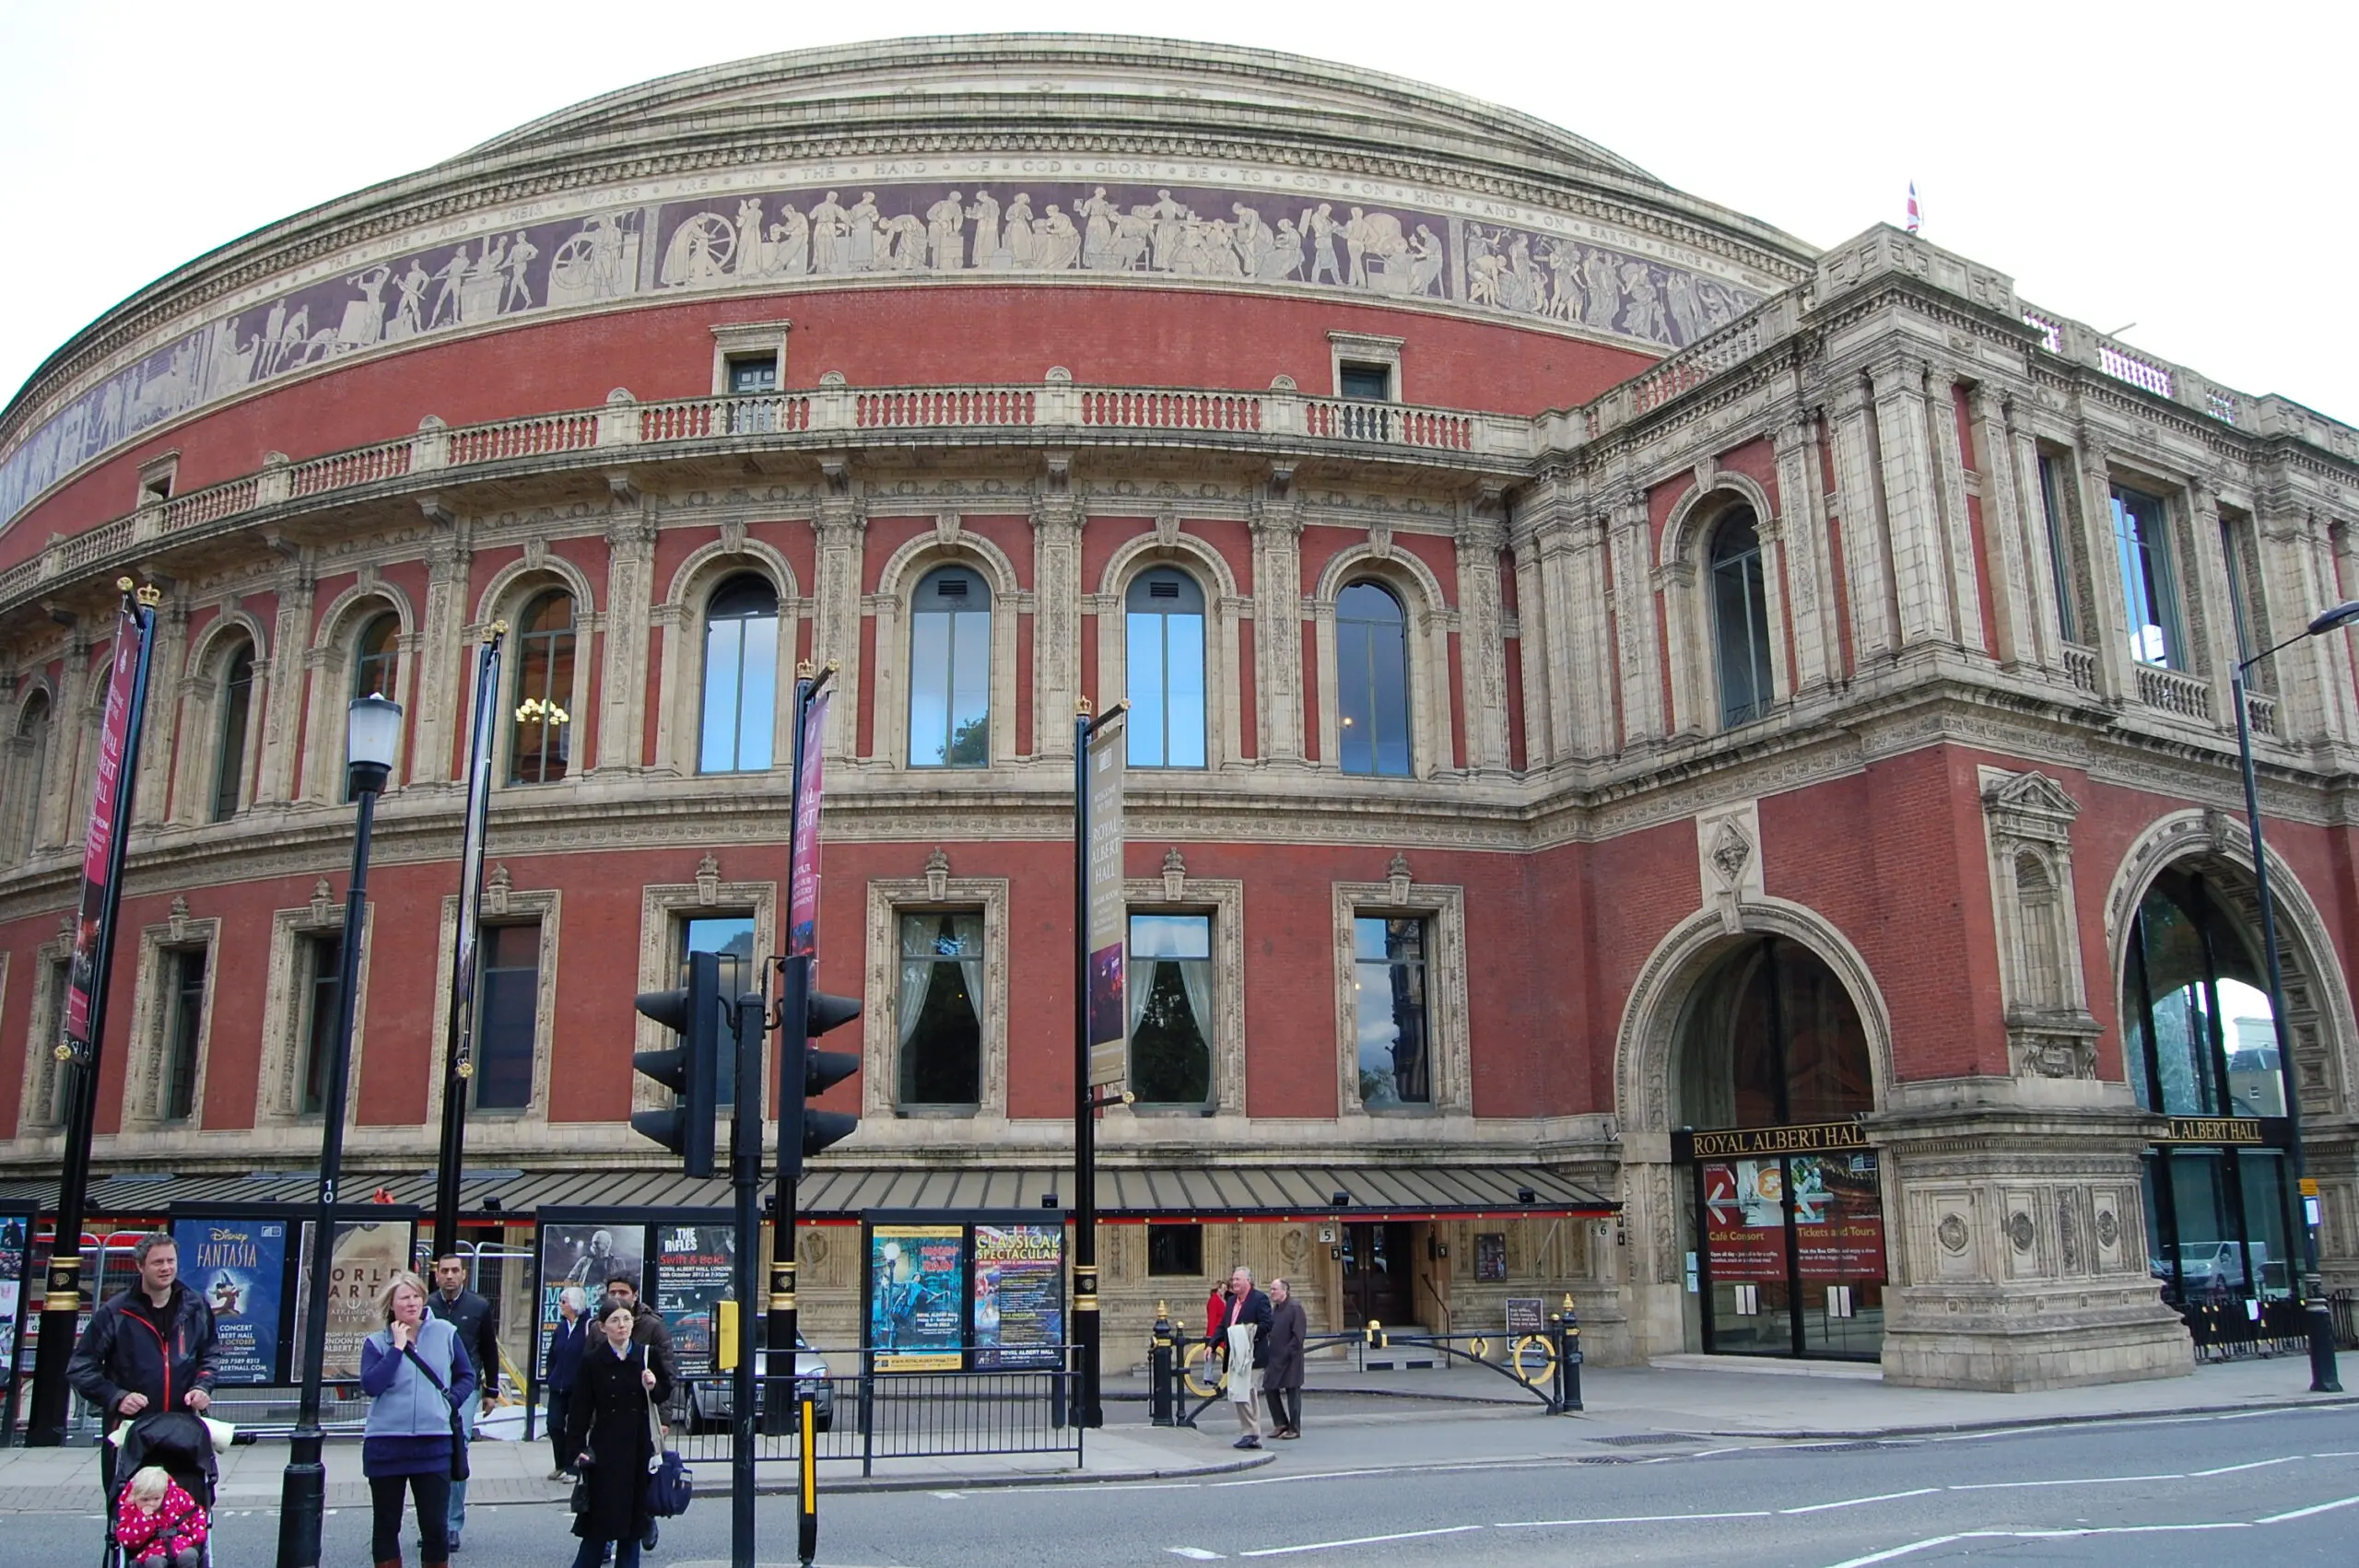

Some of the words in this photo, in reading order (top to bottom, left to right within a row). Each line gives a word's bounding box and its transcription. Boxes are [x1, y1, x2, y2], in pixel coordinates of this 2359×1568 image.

[328, 254, 352, 270] THE
[380, 237, 411, 254] WISE
[439, 221, 468, 237] AND
[499, 204, 544, 223] THEIR
[675, 178, 709, 193] ARE
[745, 172, 764, 183] IN
[802, 166, 836, 179] THE
[874, 162, 927, 175] HAND
[968, 161, 991, 173] OF
[1094, 161, 1158, 175] GLORY
[1187, 165, 1209, 179] BE
[1238, 170, 1262, 182] TO
[1293, 175, 1331, 190] GOD
[1361, 182, 1386, 196] ON
[1484, 202, 1517, 219] AND
[1543, 216, 1566, 228] ON
[1590, 226, 1637, 249] EARTH
[1093, 816, 1119, 844] ROYAL
[1091, 837, 1120, 867] ALBERT
[1096, 861, 1115, 885] HALL
[2182, 1121, 2228, 1140] ALBERT
[2230, 1122, 2263, 1140] HALL
[1694, 1133, 1749, 1154] ROYAL
[1753, 1128, 1820, 1151] ALBERT
[1825, 1125, 1871, 1146] HAL
[208, 1227, 249, 1244] Disney
[675, 1227, 696, 1240] THE
[1324, 1230, 1332, 1241] 5
[1601, 1225, 1607, 1235] 6
[1709, 1231, 1728, 1242] Café
[1730, 1230, 1765, 1241] Consort
[1798, 1226, 1828, 1237] Tickets
[1849, 1225, 1876, 1236] Tours
[664, 1235, 698, 1253] RIFLES
[977, 1235, 1060, 1248] CLASSICAL
[196, 1244, 257, 1268] FANTASIA
[659, 1254, 687, 1265] Swift
[689, 1255, 698, 1265] &
[978, 1248, 1059, 1260] SPECTACULAR
[922, 1260, 955, 1272] RAIN
